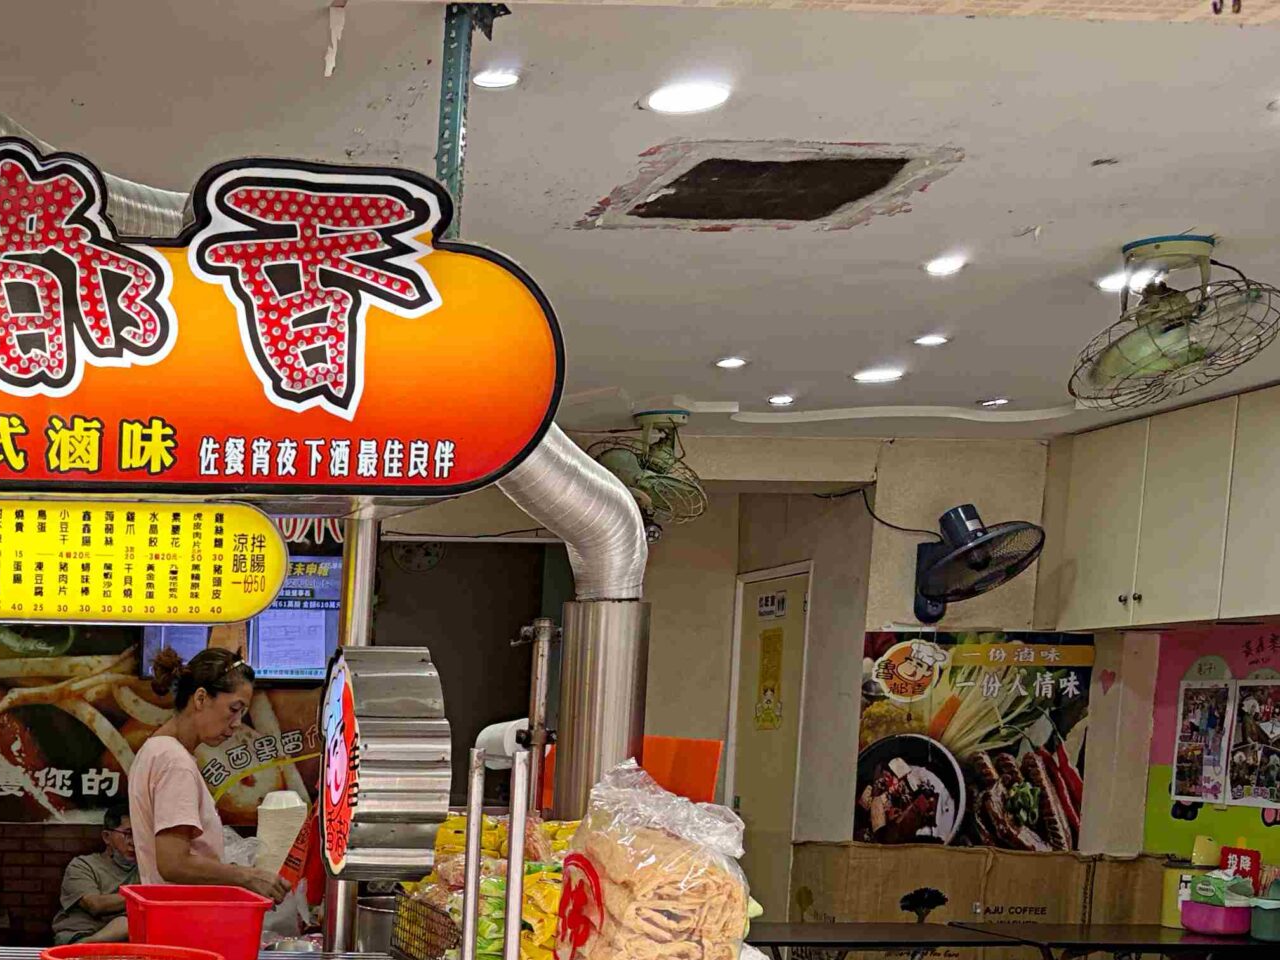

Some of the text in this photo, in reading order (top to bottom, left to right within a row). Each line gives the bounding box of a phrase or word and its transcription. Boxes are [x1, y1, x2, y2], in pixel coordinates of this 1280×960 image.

[199, 437, 455, 478] 佐餐宵夜下酒最佳良伴
[59, 510, 69, 544] 小豆干
[189, 606, 200, 614] 20
[210, 606, 222, 614] 40
[962, 647, 1063, 663] 一份滷味
[955, 671, 1081, 698] 一份人情味
[1008, 906, 1048, 915] COFFEE
